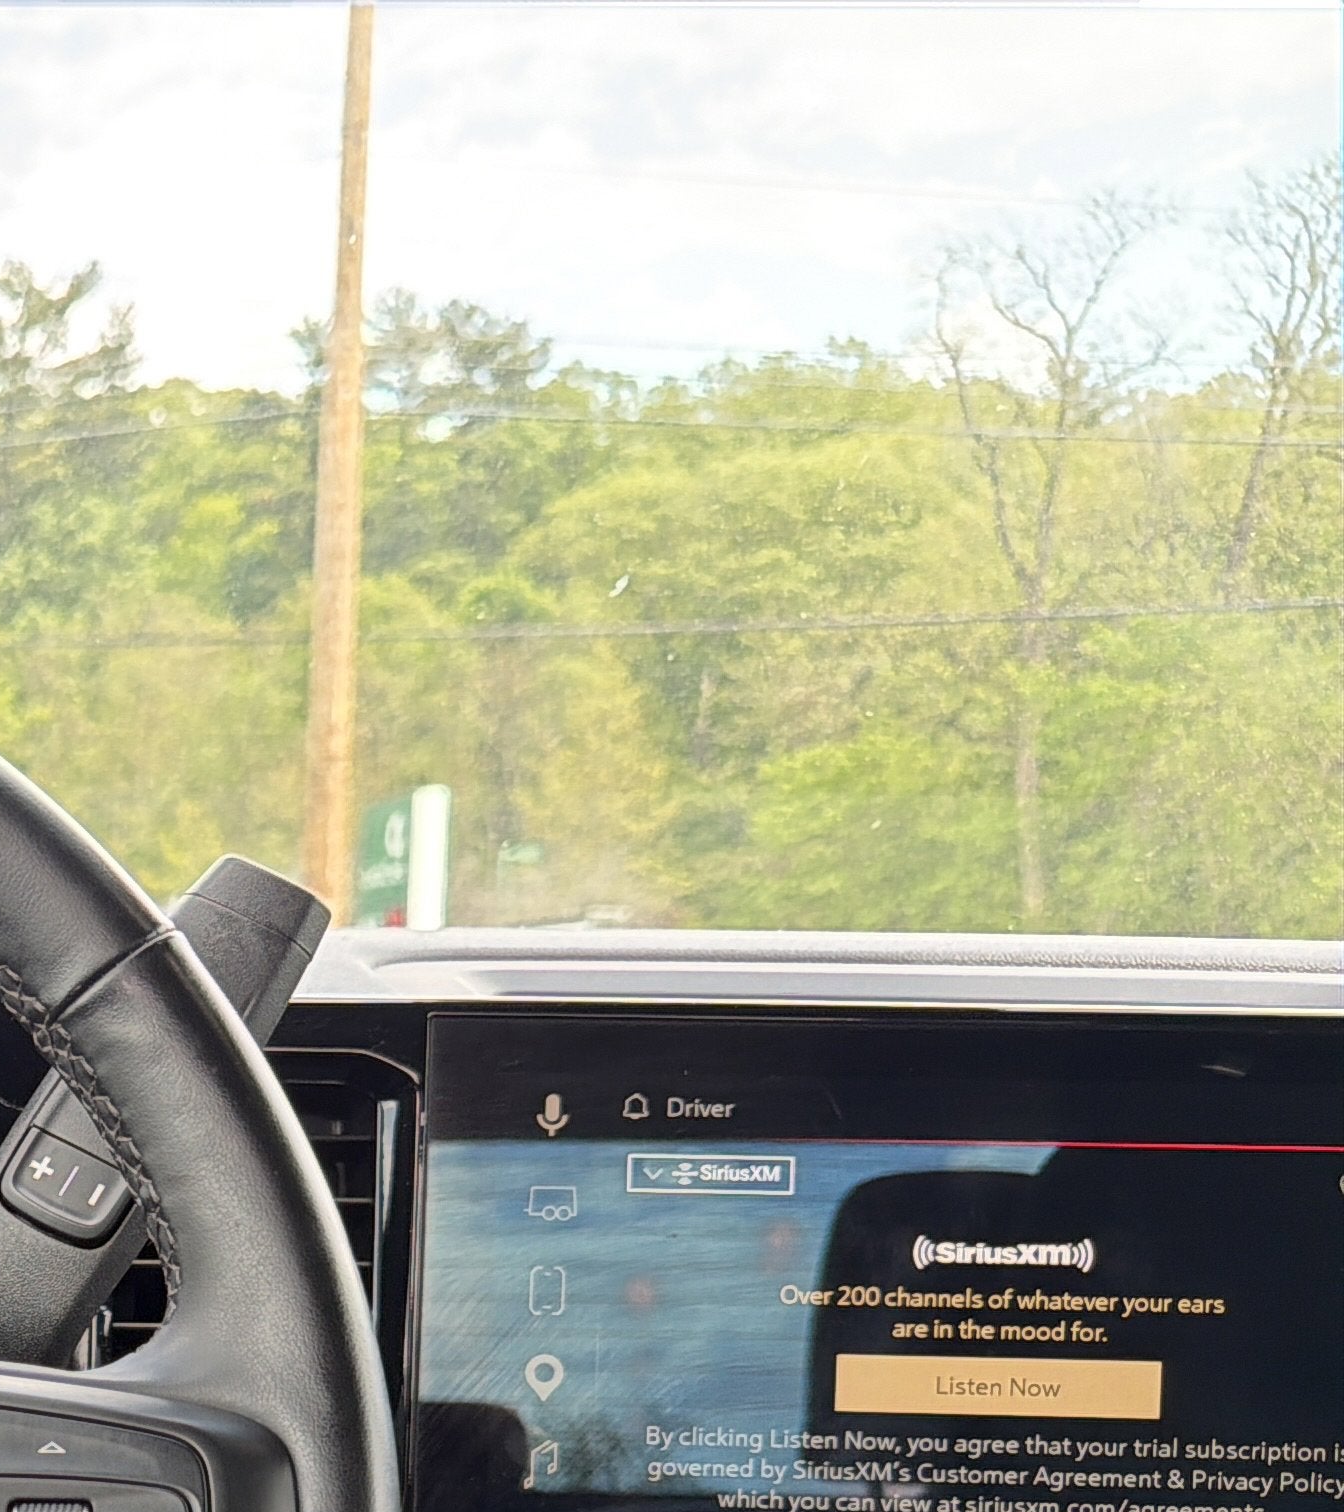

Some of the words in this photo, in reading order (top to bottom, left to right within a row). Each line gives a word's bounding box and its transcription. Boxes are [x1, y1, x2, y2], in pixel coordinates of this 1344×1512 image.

[666, 1096, 735, 1118] Driver
[699, 1164, 780, 1182] SiriusXM
[779, 1284, 834, 1305] Over
[836, 1285, 881, 1306] 200
[883, 1285, 983, 1309] channels
[987, 1287, 1014, 1309] of
[1016, 1289, 1118, 1312] whatever
[1121, 1297, 1172, 1317] your
[1177, 1297, 1225, 1314] ears
[891, 1321, 928, 1338] are
[932, 1318, 953, 1338] in
[957, 1318, 995, 1340] the
[999, 1320, 1065, 1341] mood
[1069, 1319, 1107, 1342] for.
[935, 1375, 1002, 1396] Listen
[1009, 1377, 1061, 1397] Now
[645, 1425, 672, 1449] By
[678, 1426, 762, 1450] clicking
[770, 1429, 837, 1449] Listen
[844, 1430, 900, 1454] Now,
[906, 1436, 948, 1457] you
[953, 1437, 1019, 1458] agree
[1024, 1434, 1071, 1456] that
[1074, 1440, 1126, 1461] your
[1133, 1437, 1178, 1458] trial
[1184, 1438, 1325, 1465] subscription
[647, 1458, 753, 1481] governed
[760, 1459, 787, 1482] by
[792, 1460, 911, 1482] SiriusXM's
[916, 1462, 1027, 1486] Customer
[1032, 1465, 1161, 1492] Agreement
[1166, 1469, 1184, 1489] &
[1191, 1469, 1273, 1497] Privacy
[1279, 1471, 1344, 1499] Policy
[717, 1490, 783, 1511] which
[835, 1497, 874, 1512] can
[880, 1495, 931, 1512] view
